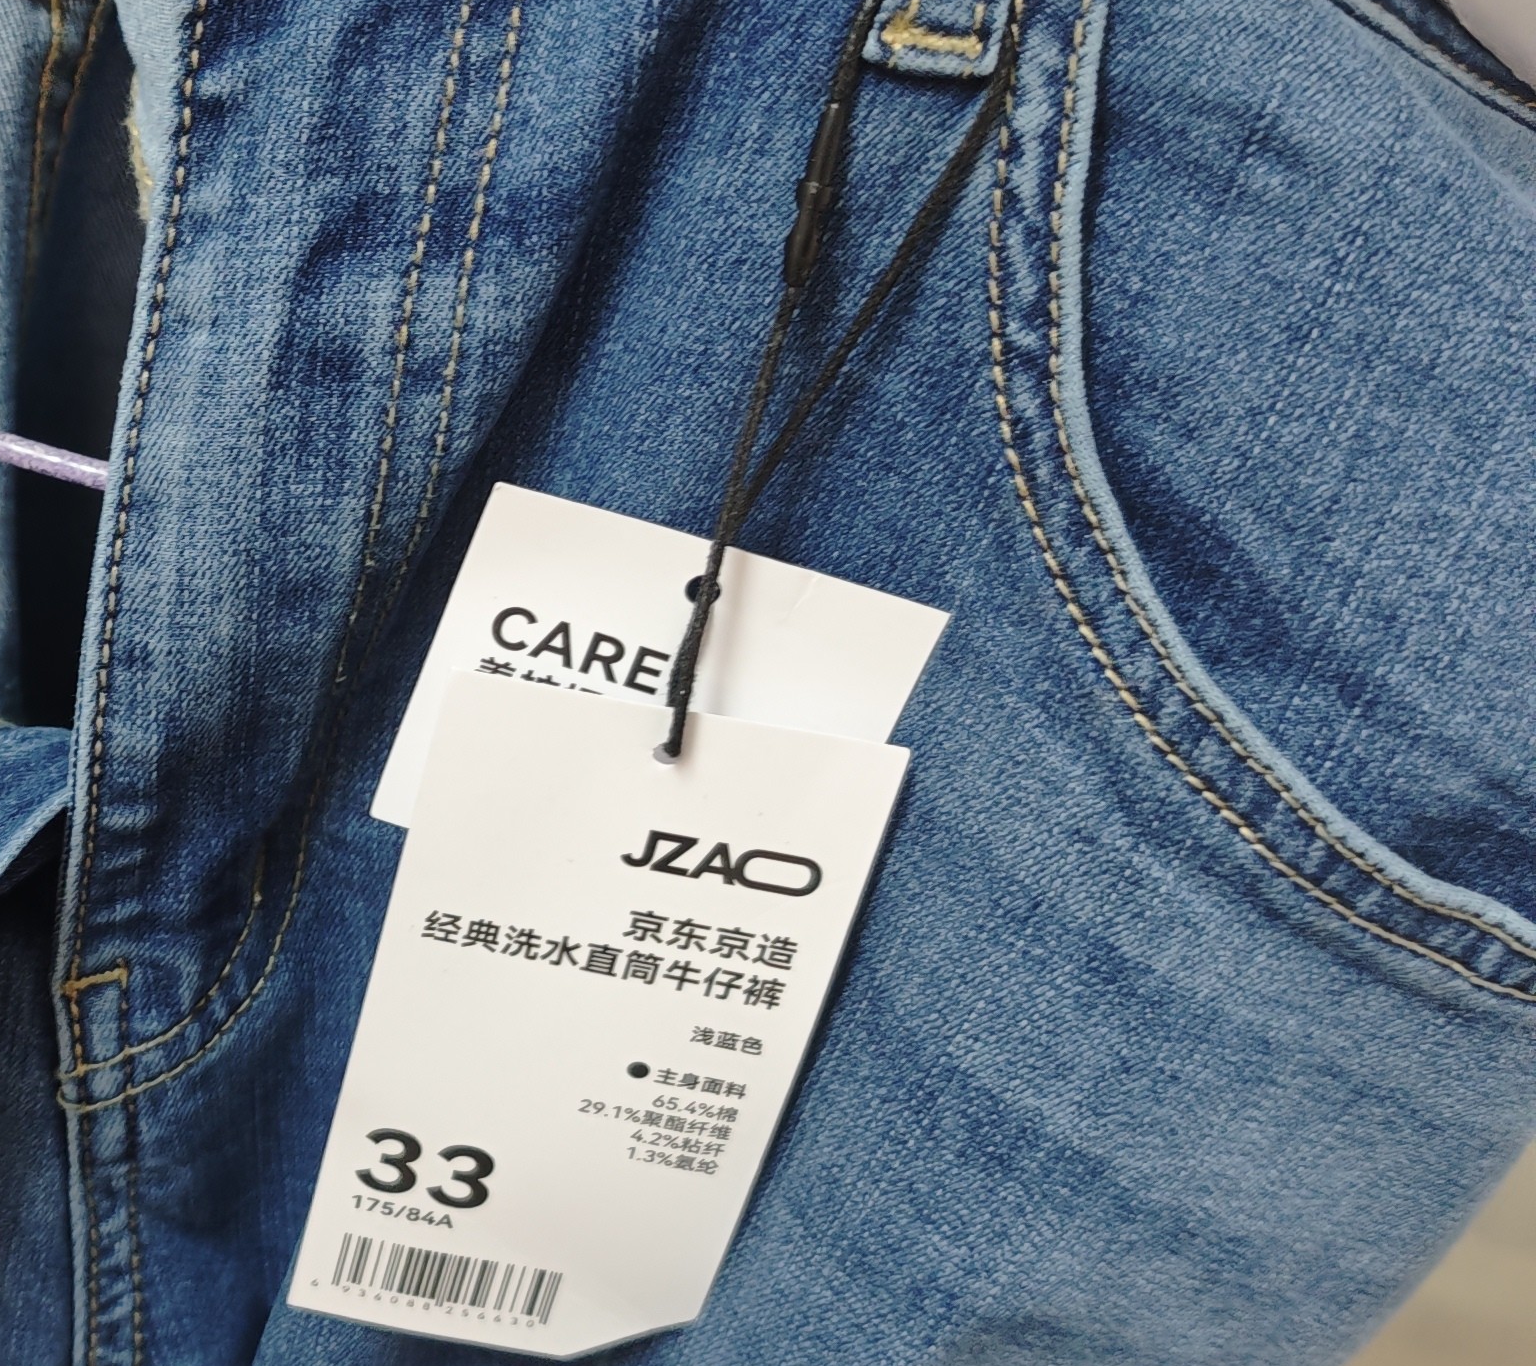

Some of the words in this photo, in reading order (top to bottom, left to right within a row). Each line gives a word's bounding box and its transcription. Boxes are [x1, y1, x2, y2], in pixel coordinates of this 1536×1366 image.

[491, 606, 672, 695] CARE
[620, 829, 822, 897] JZAO
[420, 909, 787, 1010] 经典洗水直筒牛仔裤
[622, 909, 799, 972] 京东京造
[689, 1025, 764, 1056] 浅蓝色
[652, 1067, 747, 1100] 主身面料
[577, 1098, 733, 1141] 29.1%聚酯纤维
[651, 1094, 739, 1123] 65.4%棉
[630, 1128, 726, 1158] 4.2%粘纤
[354, 1127, 496, 1209] 33
[351, 1194, 454, 1229] 175/84A
